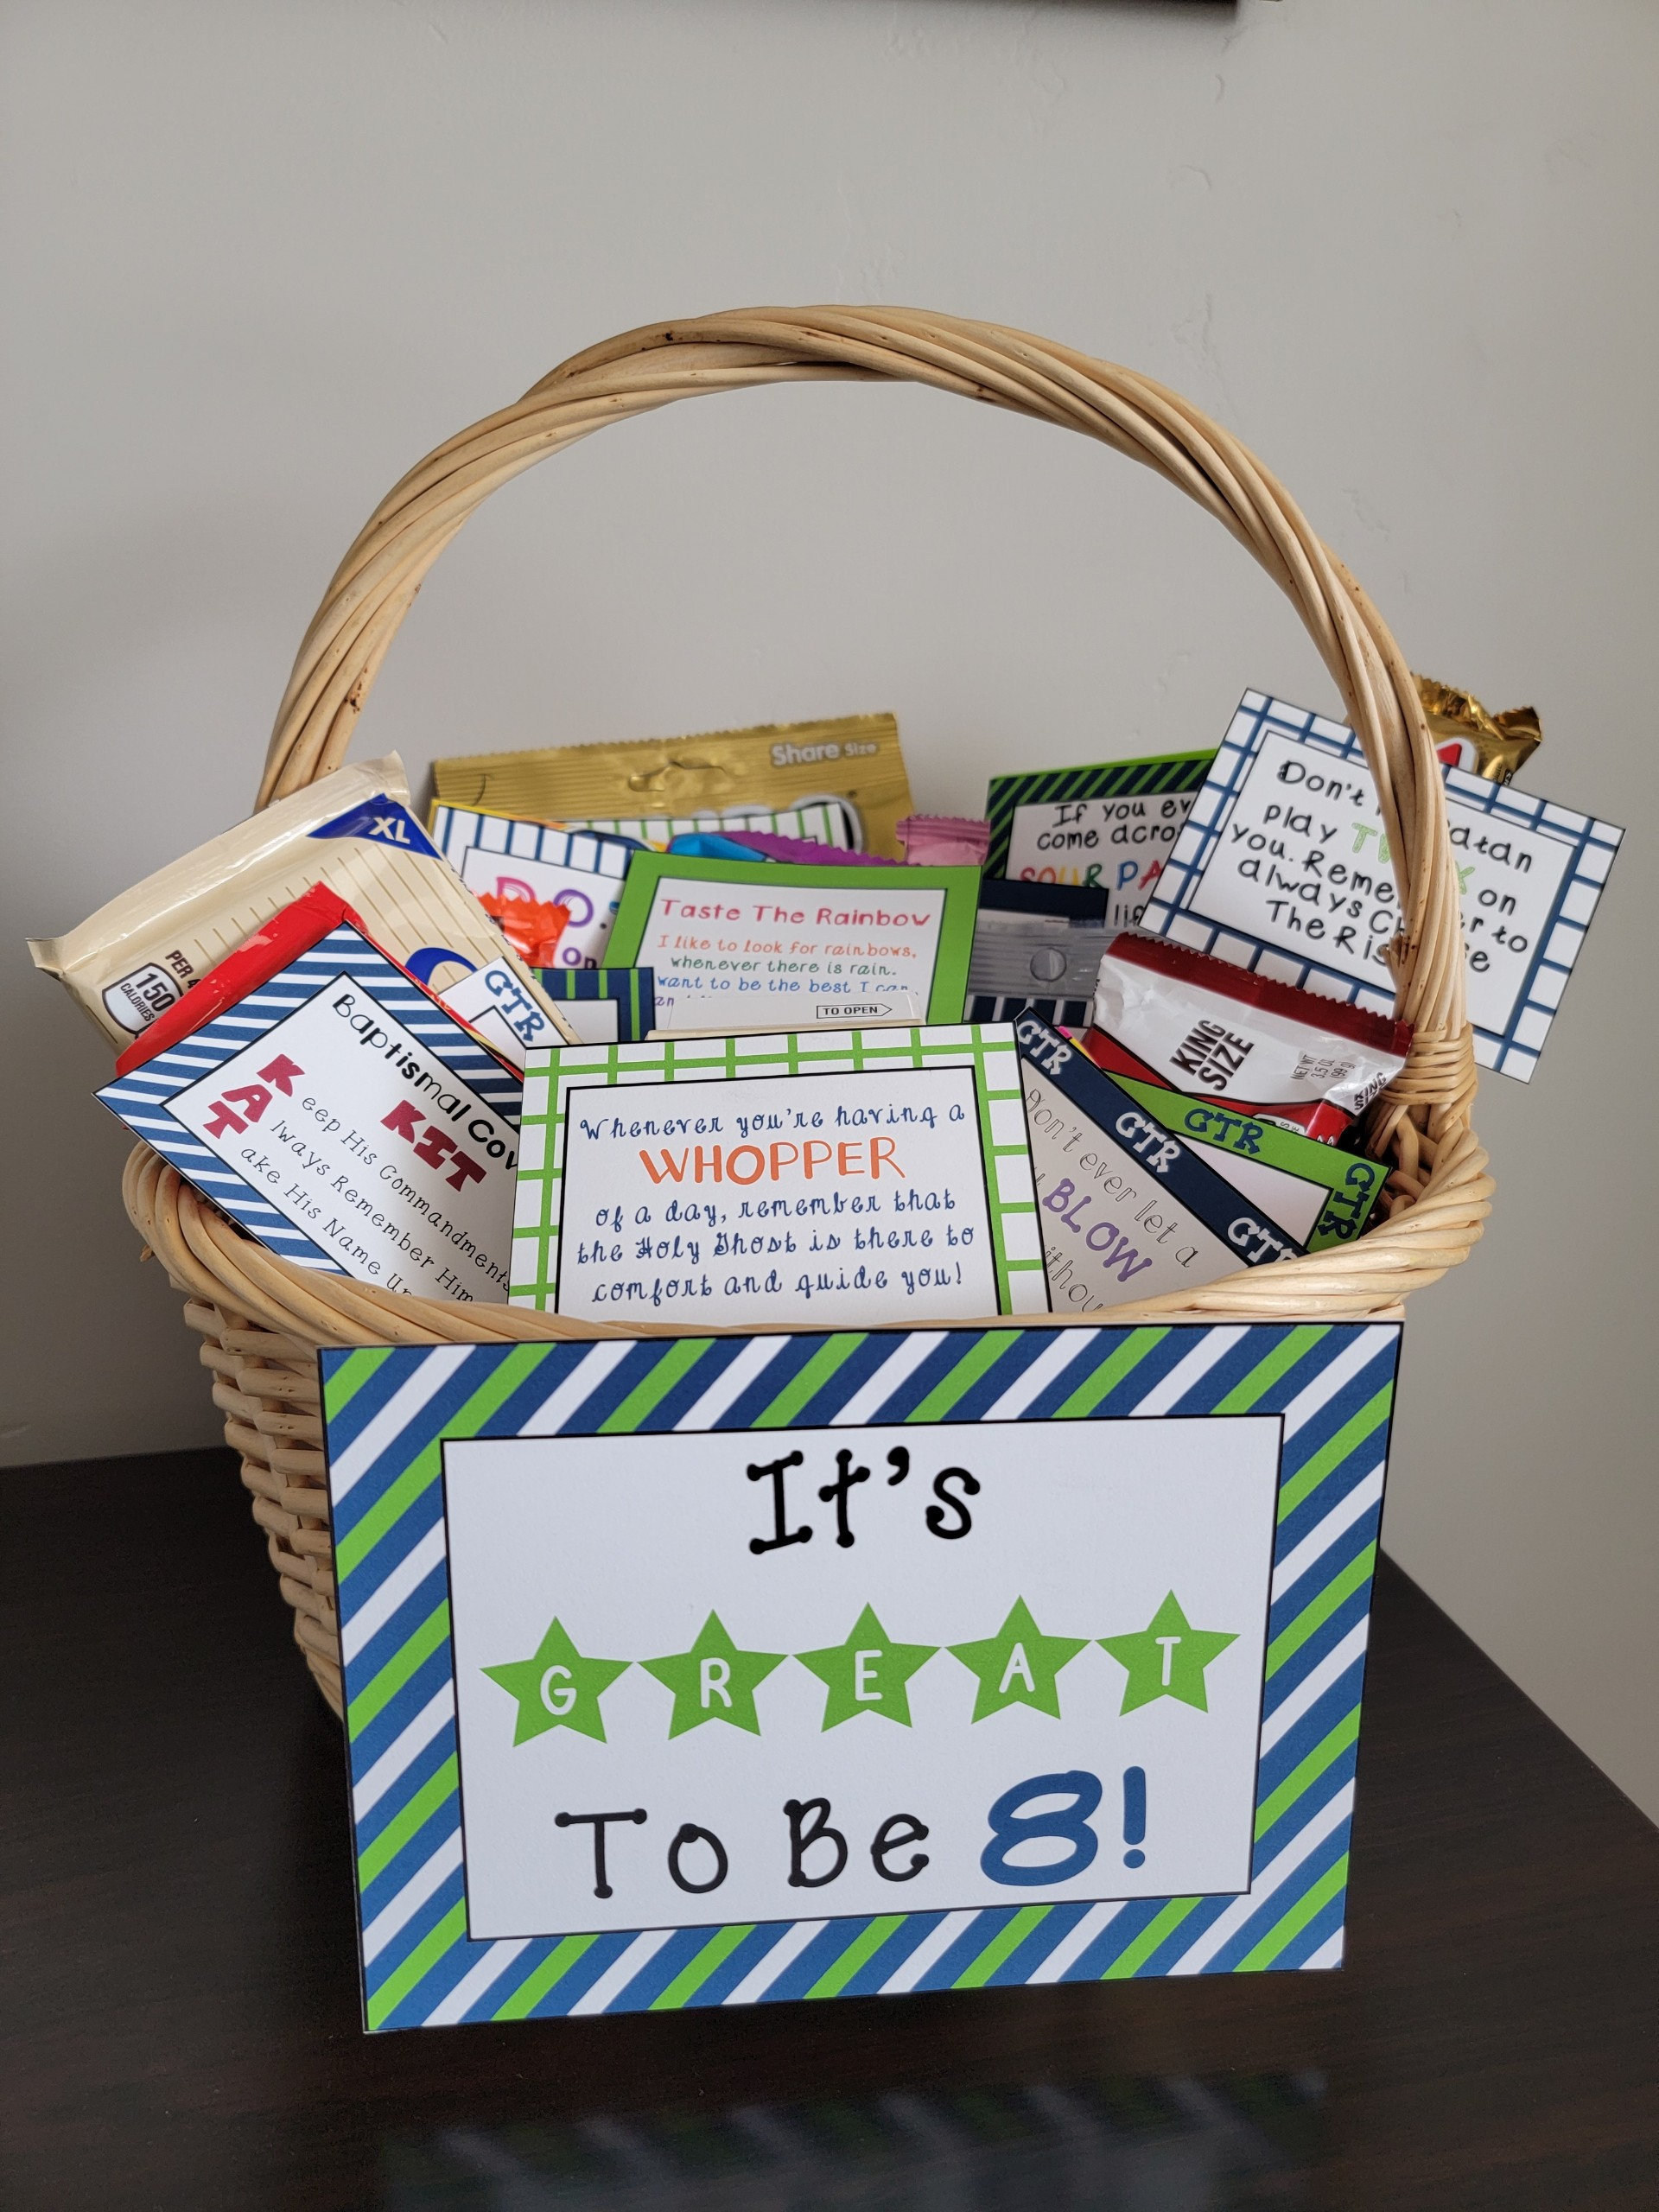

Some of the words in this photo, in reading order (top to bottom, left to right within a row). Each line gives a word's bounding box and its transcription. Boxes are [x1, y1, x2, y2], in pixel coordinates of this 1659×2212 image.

[772, 744, 840, 766] Share
[844, 743, 877, 756] Size
[370, 817, 411, 845] XL
[1052, 803, 1088, 828] If
[1103, 802, 1146, 822] you
[1277, 760, 1365, 806] Don't
[1446, 819, 1533, 874] atan
[1037, 829, 1099, 850] come
[1110, 824, 1182, 844] acro
[1262, 805, 1338, 844] play
[1478, 888, 1516, 916] on
[1231, 823, 1294, 862] you.
[1491, 926, 1528, 952] to
[1237, 859, 1362, 918] always
[660, 899, 741, 921] Taste
[753, 906, 805, 925] The
[815, 907, 931, 928] Rainbow
[1266, 900, 1325, 939] The
[165, 950, 194, 979] PER
[657, 935, 669, 948] I
[675, 936, 711, 950] like
[717, 939, 738, 952] to
[743, 939, 783, 954] look
[790, 941, 817, 955] for
[657, 975, 703, 988] want
[709, 976, 731, 990] to
[739, 977, 761, 992] be
[768, 977, 801, 992] the
[809, 979, 851, 994] best
[671, 956, 761, 971] whenever
[767, 959, 820, 974] there
[827, 961, 842, 974] is
[849, 963, 897, 976] rain.
[120, 982, 155, 1022] CALORIES
[136, 972, 175, 1012] 150
[823, 1007, 839, 1015] TO
[843, 1006, 878, 1014] OPEN
[332, 994, 472, 1122] Baptismal
[1169, 1020, 1226, 1076] KING
[1198, 1032, 1255, 1091] SIZE
[1290, 1065, 1311, 1079] NET
[1311, 1066, 1328, 1078] 3.5
[1354, 1072, 1387, 1101] KING
[580, 1117, 723, 1140] Whenever
[736, 1107, 824, 1137] you're
[836, 1103, 937, 1127] having
[949, 1103, 965, 1122] a
[340, 1129, 378, 1165] His
[380, 1099, 486, 1192] KIT
[639, 1136, 906, 1185] WHOPPER
[283, 1183, 321, 1219] His
[322, 1217, 381, 1275] Name
[330, 1175, 435, 1268] Remember
[595, 1207, 624, 1233] of
[635, 1205, 651, 1224] a
[665, 1199, 728, 1225] day,
[739, 1192, 881, 1219] remember
[893, 1188, 955, 1211] that
[1042, 1178, 1153, 1282] BLOW
[1079, 1153, 1136, 1202] ever
[1135, 1199, 1178, 1243] let
[1175, 1246, 1198, 1268] a
[577, 1239, 623, 1265] the
[635, 1234, 700, 1263] Holy
[713, 1230, 798, 1256] Ghost
[809, 1230, 841, 1252] is
[855, 1228, 933, 1249] there
[947, 1225, 975, 1246] to
[591, 1274, 713, 1306] comfort
[724, 1268, 783, 1294] and
[795, 1266, 888, 1299] guide
[901, 1262, 963, 1292] you!
[747, 1446, 980, 1554] It's
[556, 1808, 729, 1899] To
[784, 1796, 930, 1890] Be
[981, 1765, 1147, 1887] 8!
